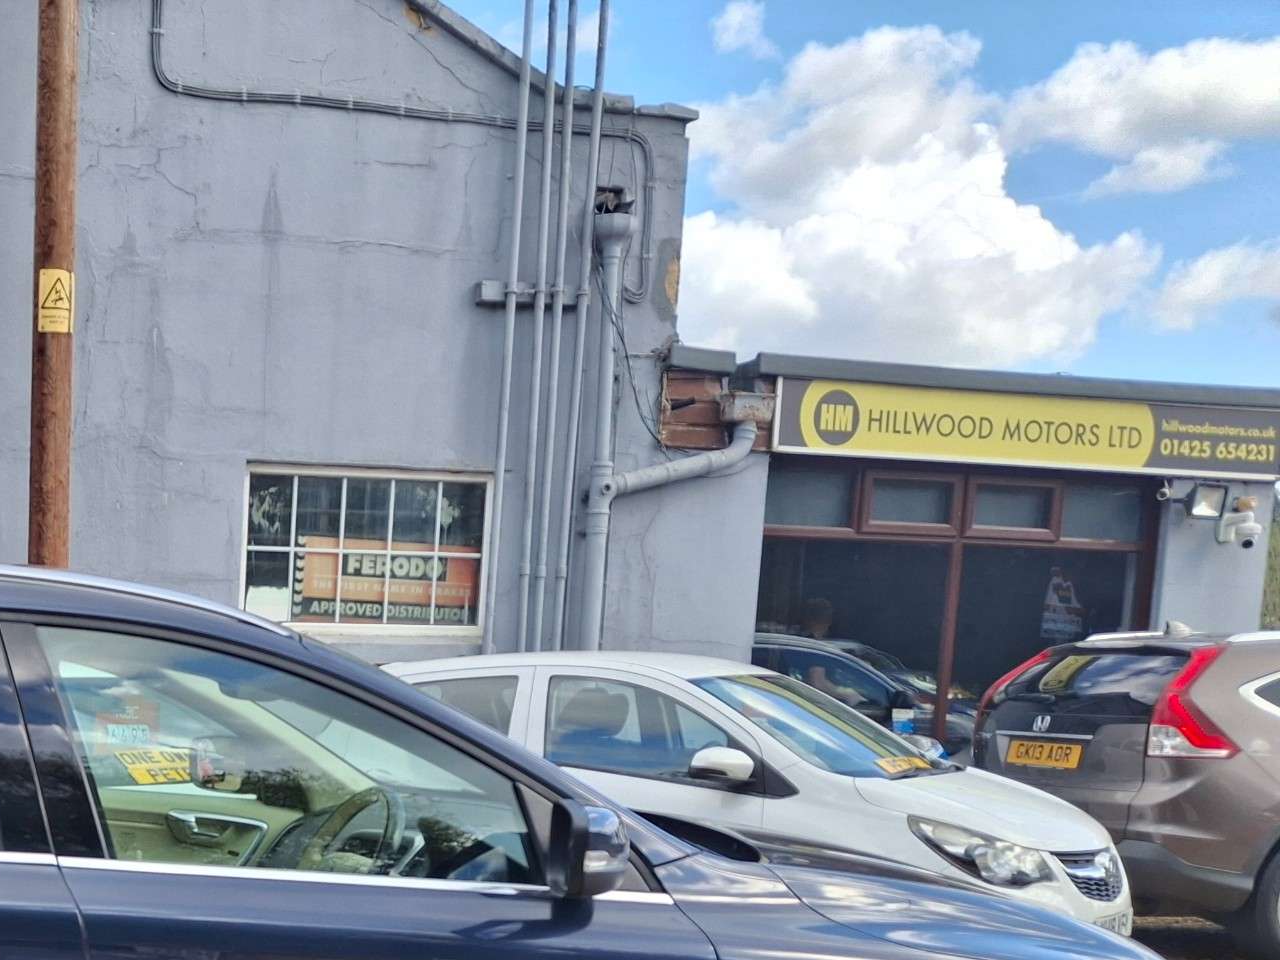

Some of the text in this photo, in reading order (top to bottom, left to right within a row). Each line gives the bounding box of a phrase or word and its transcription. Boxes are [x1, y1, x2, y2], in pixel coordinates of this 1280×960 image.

[820, 403, 854, 432] HM
[867, 408, 1142, 449] HILLWOOD MOTORS LTD
[1160, 438, 1275, 461] 01425 654231
[346, 553, 443, 579] FERODO
[309, 600, 382, 618] APPROVED
[119, 751, 160, 765] ONE
[1015, 743, 1044, 760] GK13
